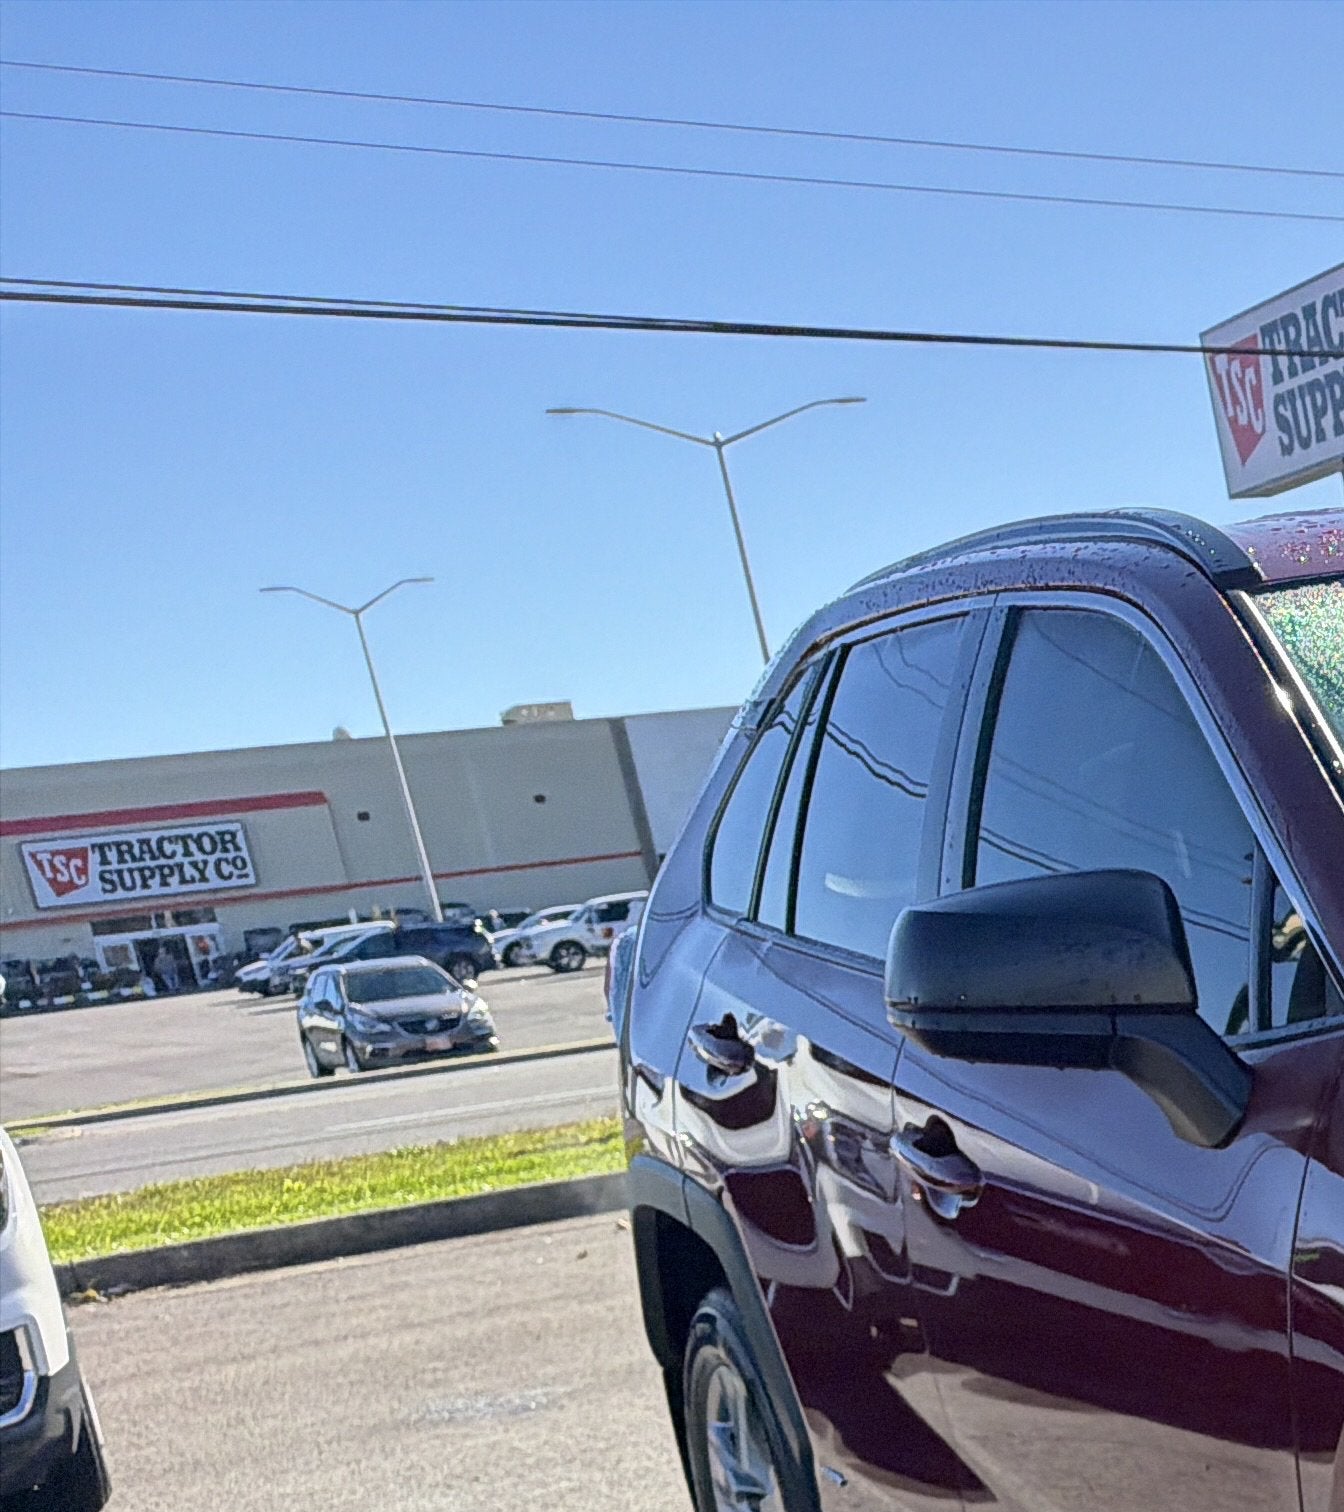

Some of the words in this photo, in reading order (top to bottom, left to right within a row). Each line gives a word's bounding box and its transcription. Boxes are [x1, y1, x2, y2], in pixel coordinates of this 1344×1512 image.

[1214, 354, 1264, 434] TSC
[91, 829, 243, 867] TRACTOR
[35, 852, 87, 886] TSC
[98, 861, 210, 895] SUPPLY
